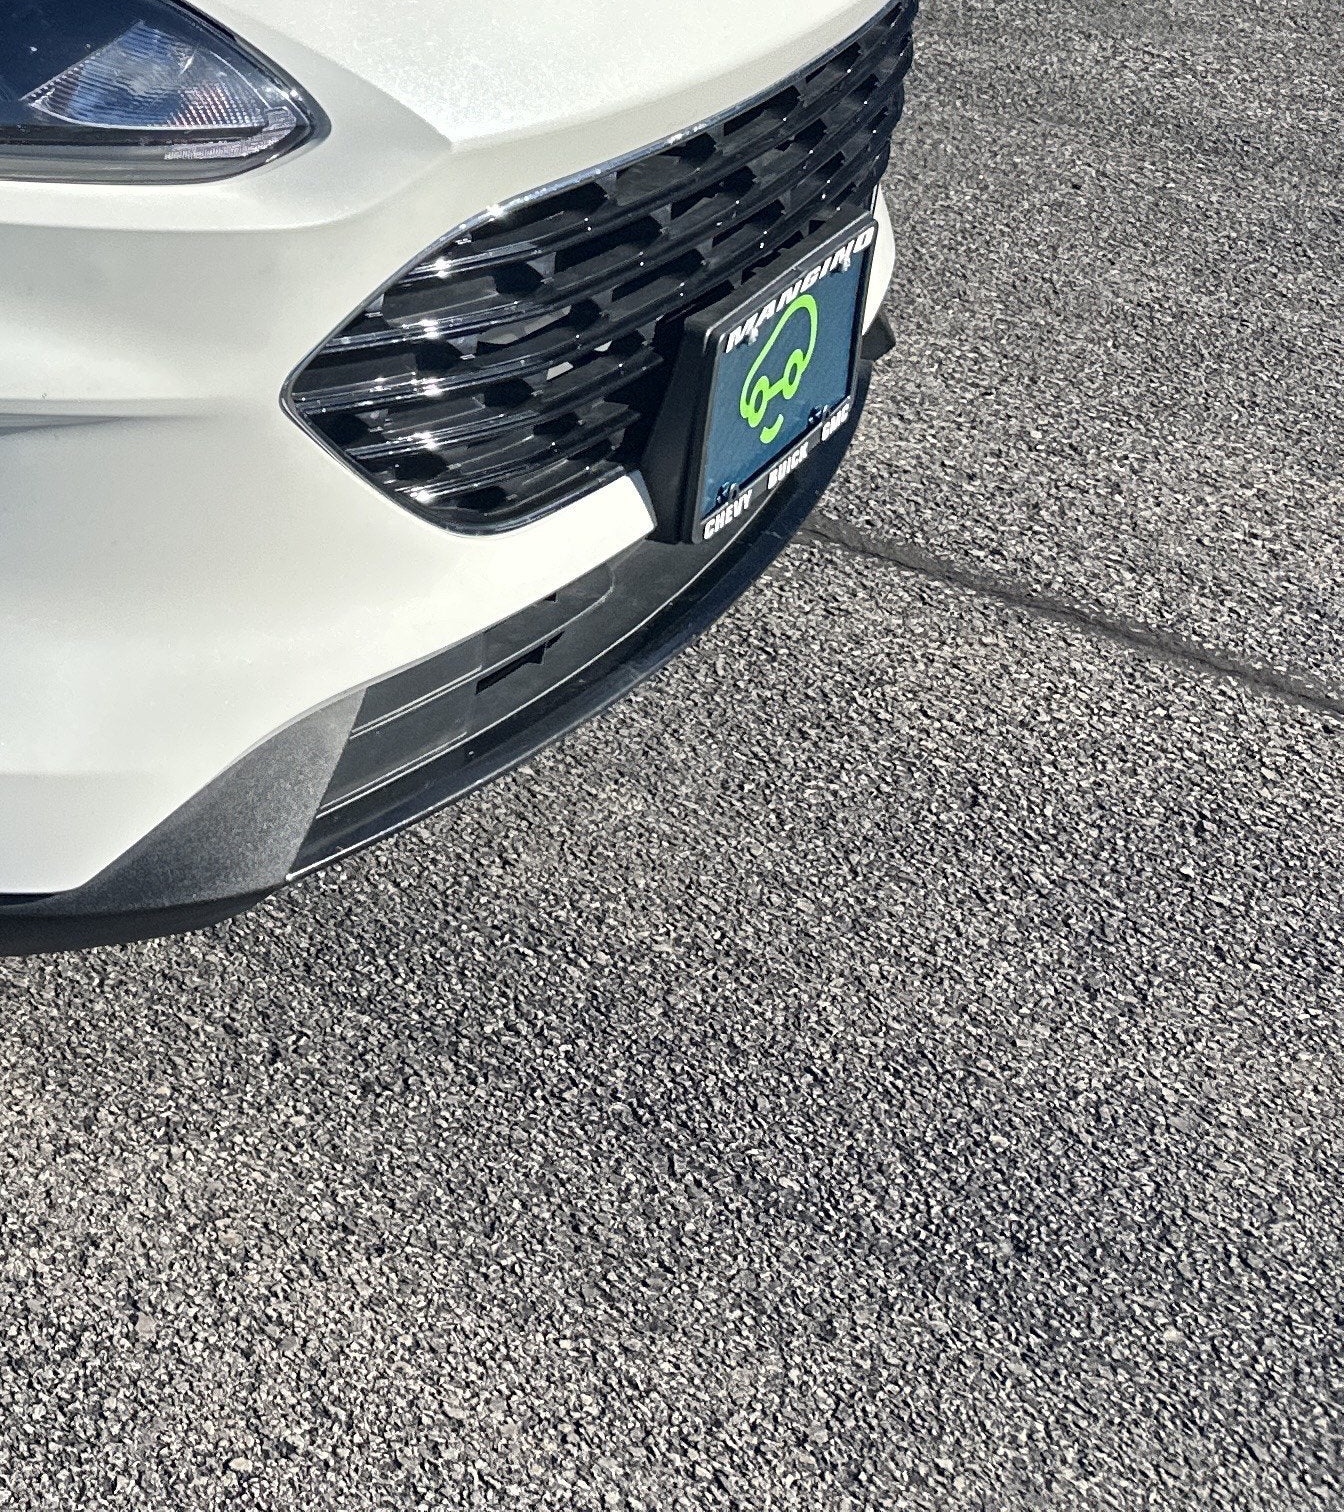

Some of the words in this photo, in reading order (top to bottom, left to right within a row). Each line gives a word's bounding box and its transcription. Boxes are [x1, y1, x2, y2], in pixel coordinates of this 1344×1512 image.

[725, 226, 875, 354] MANGINO
[703, 488, 753, 540] CHEVY
[768, 441, 809, 489] BUICK
[821, 403, 850, 441] GMC
